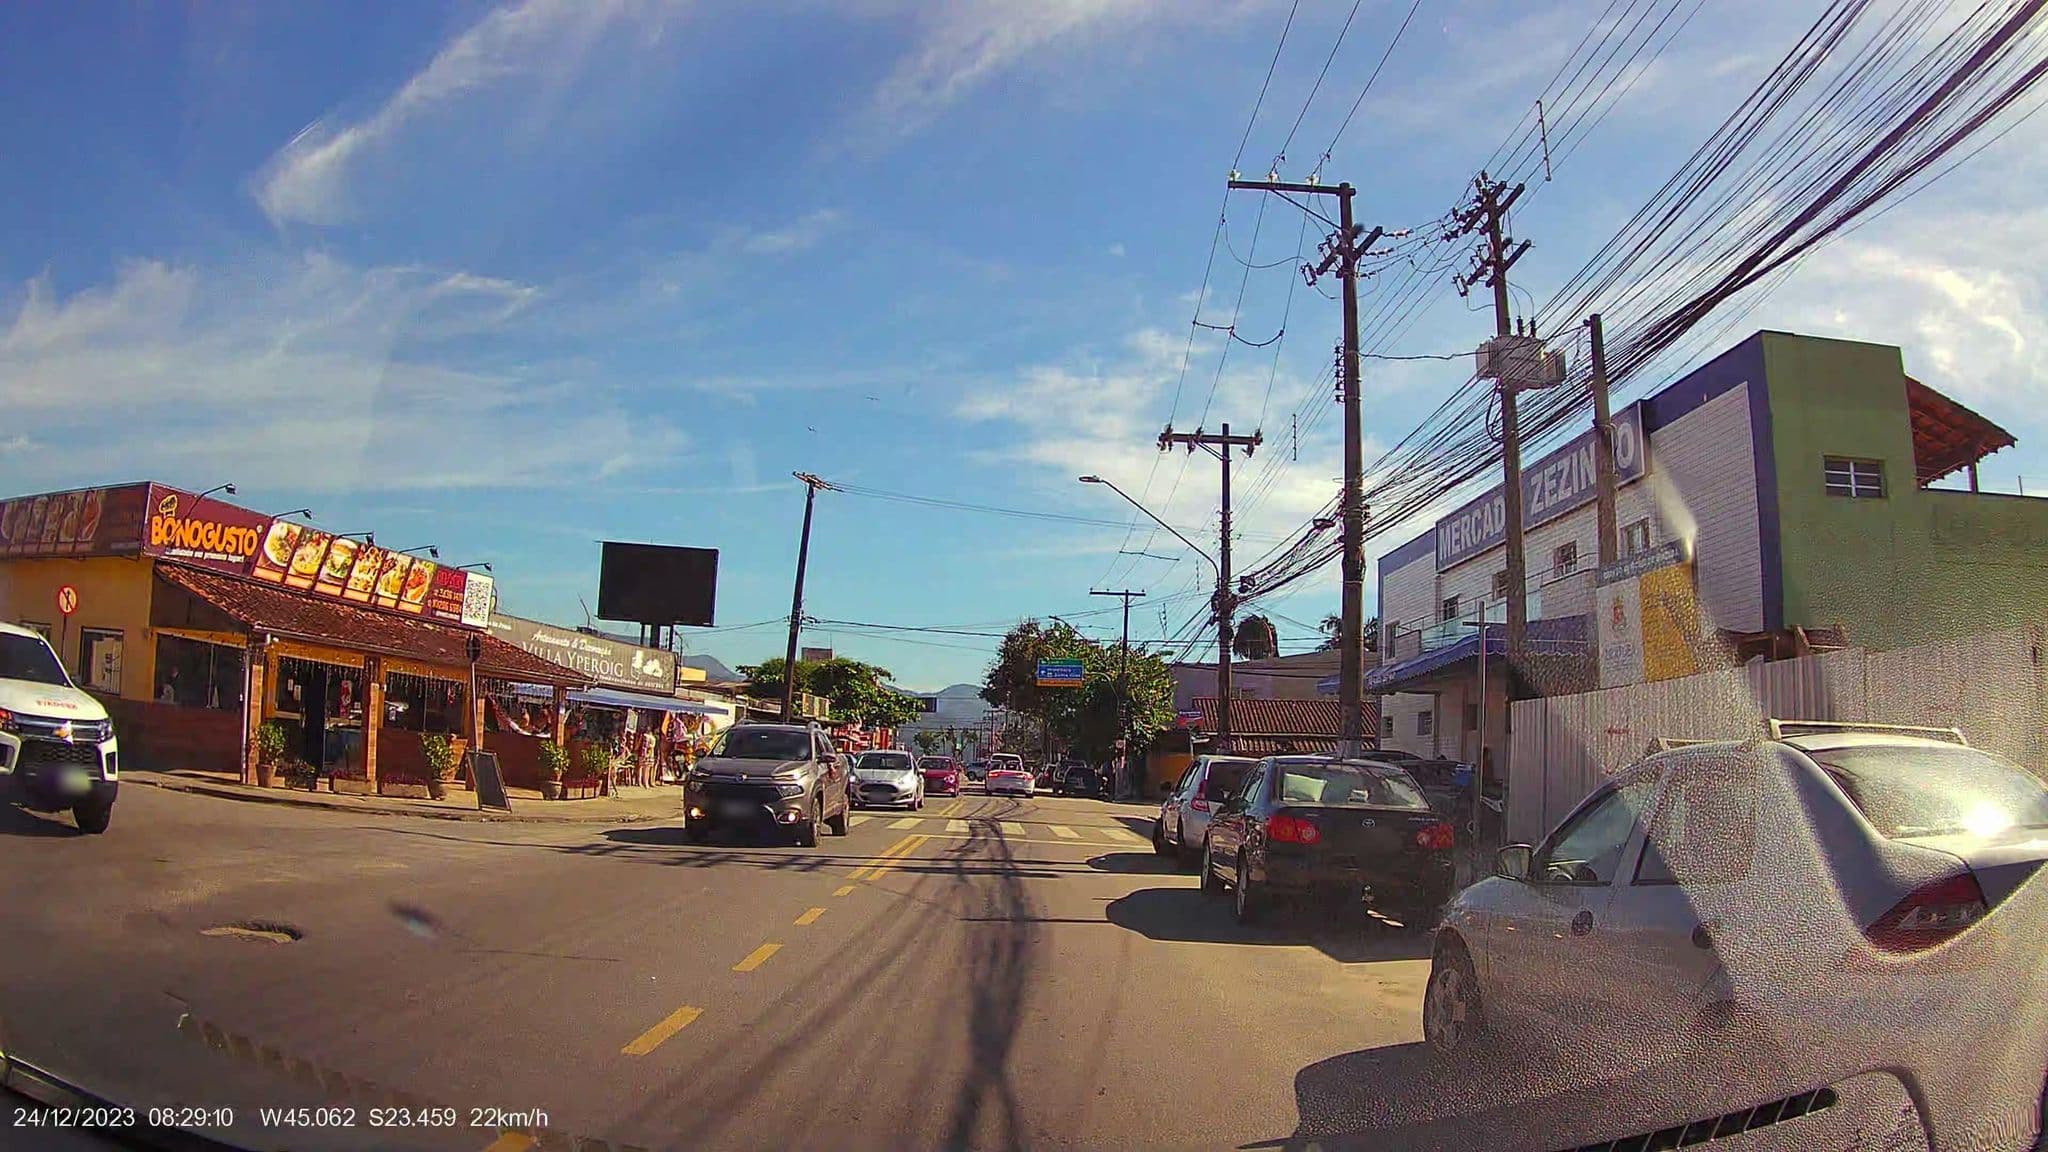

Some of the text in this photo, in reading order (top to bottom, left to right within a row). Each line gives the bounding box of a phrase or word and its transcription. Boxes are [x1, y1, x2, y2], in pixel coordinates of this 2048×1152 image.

[1439, 422, 1634, 561] MERCAD ZEZINO
[151, 515, 259, 556] BONOGUSTO
[566, 651, 624, 678] YPEROIG
